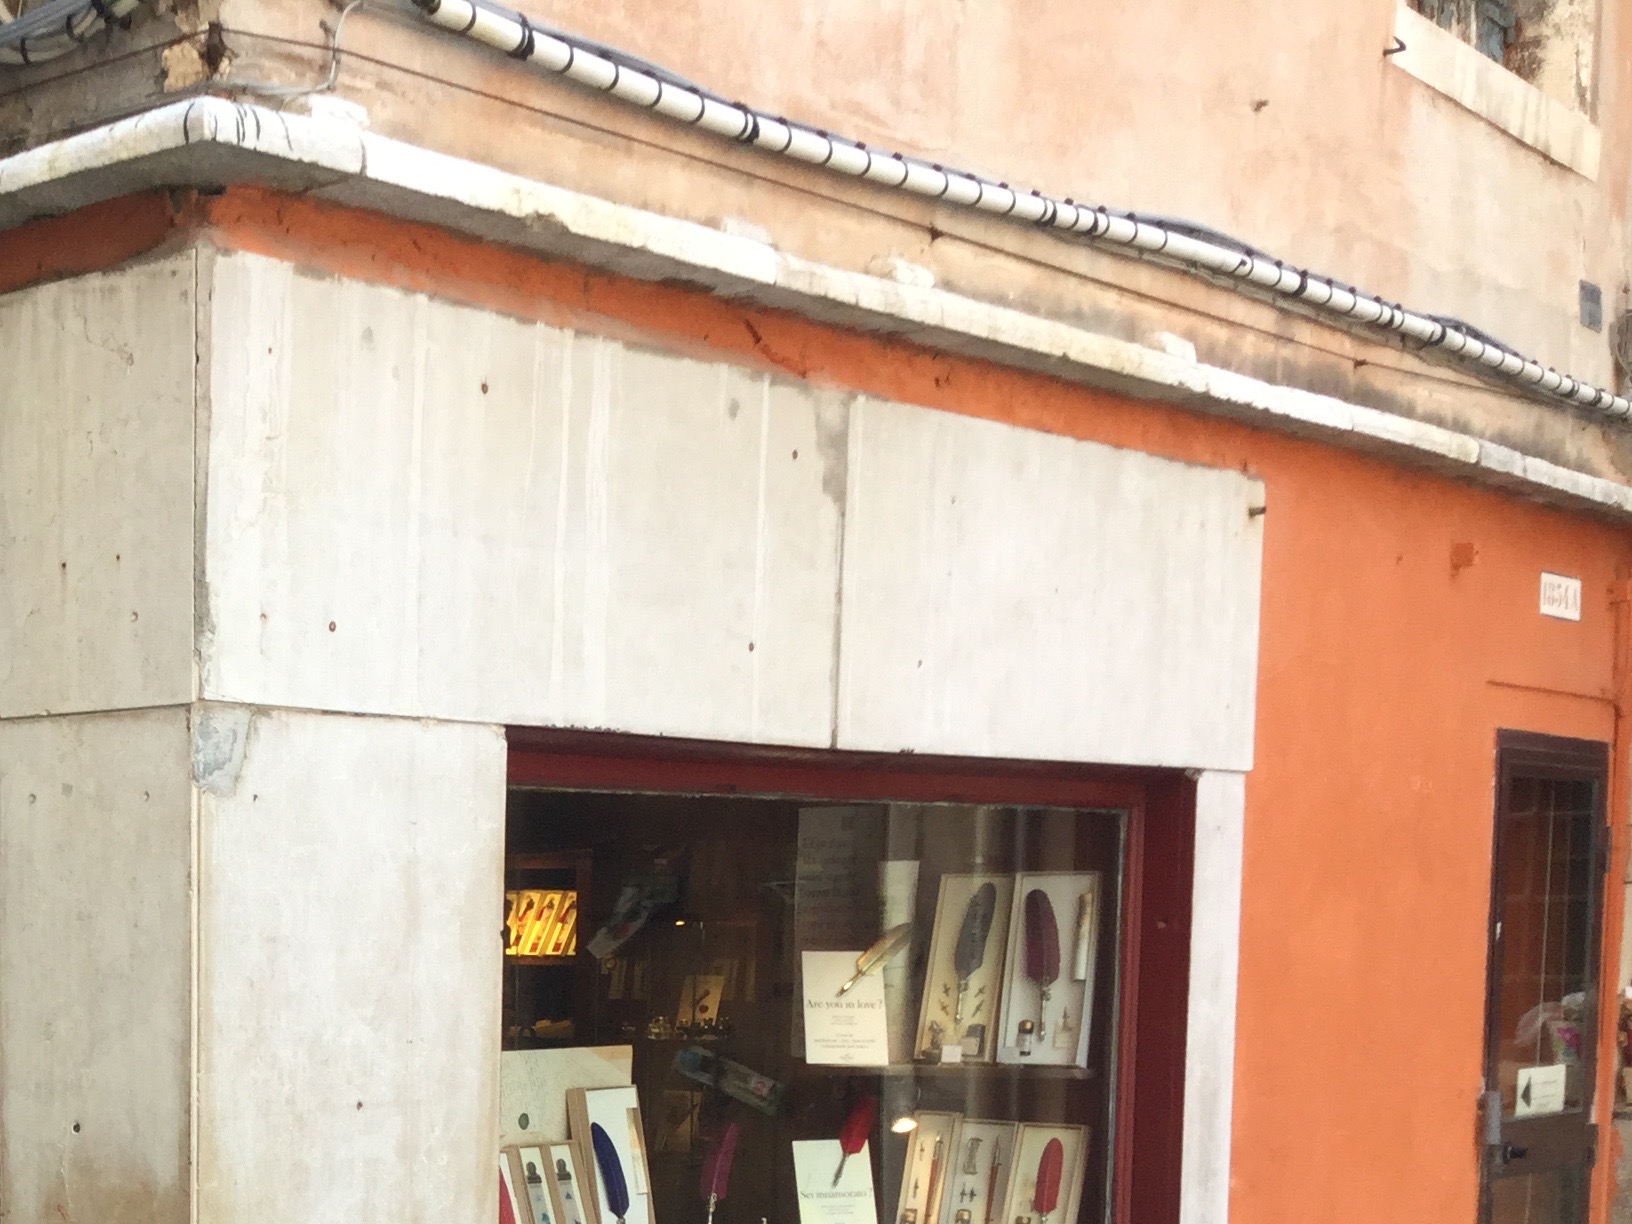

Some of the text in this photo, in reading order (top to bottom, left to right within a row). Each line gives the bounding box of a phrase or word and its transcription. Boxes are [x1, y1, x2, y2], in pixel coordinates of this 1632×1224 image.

[806, 999, 823, 1008] Are
[826, 1001, 843, 1010] you
[857, 999, 876, 1009] love
